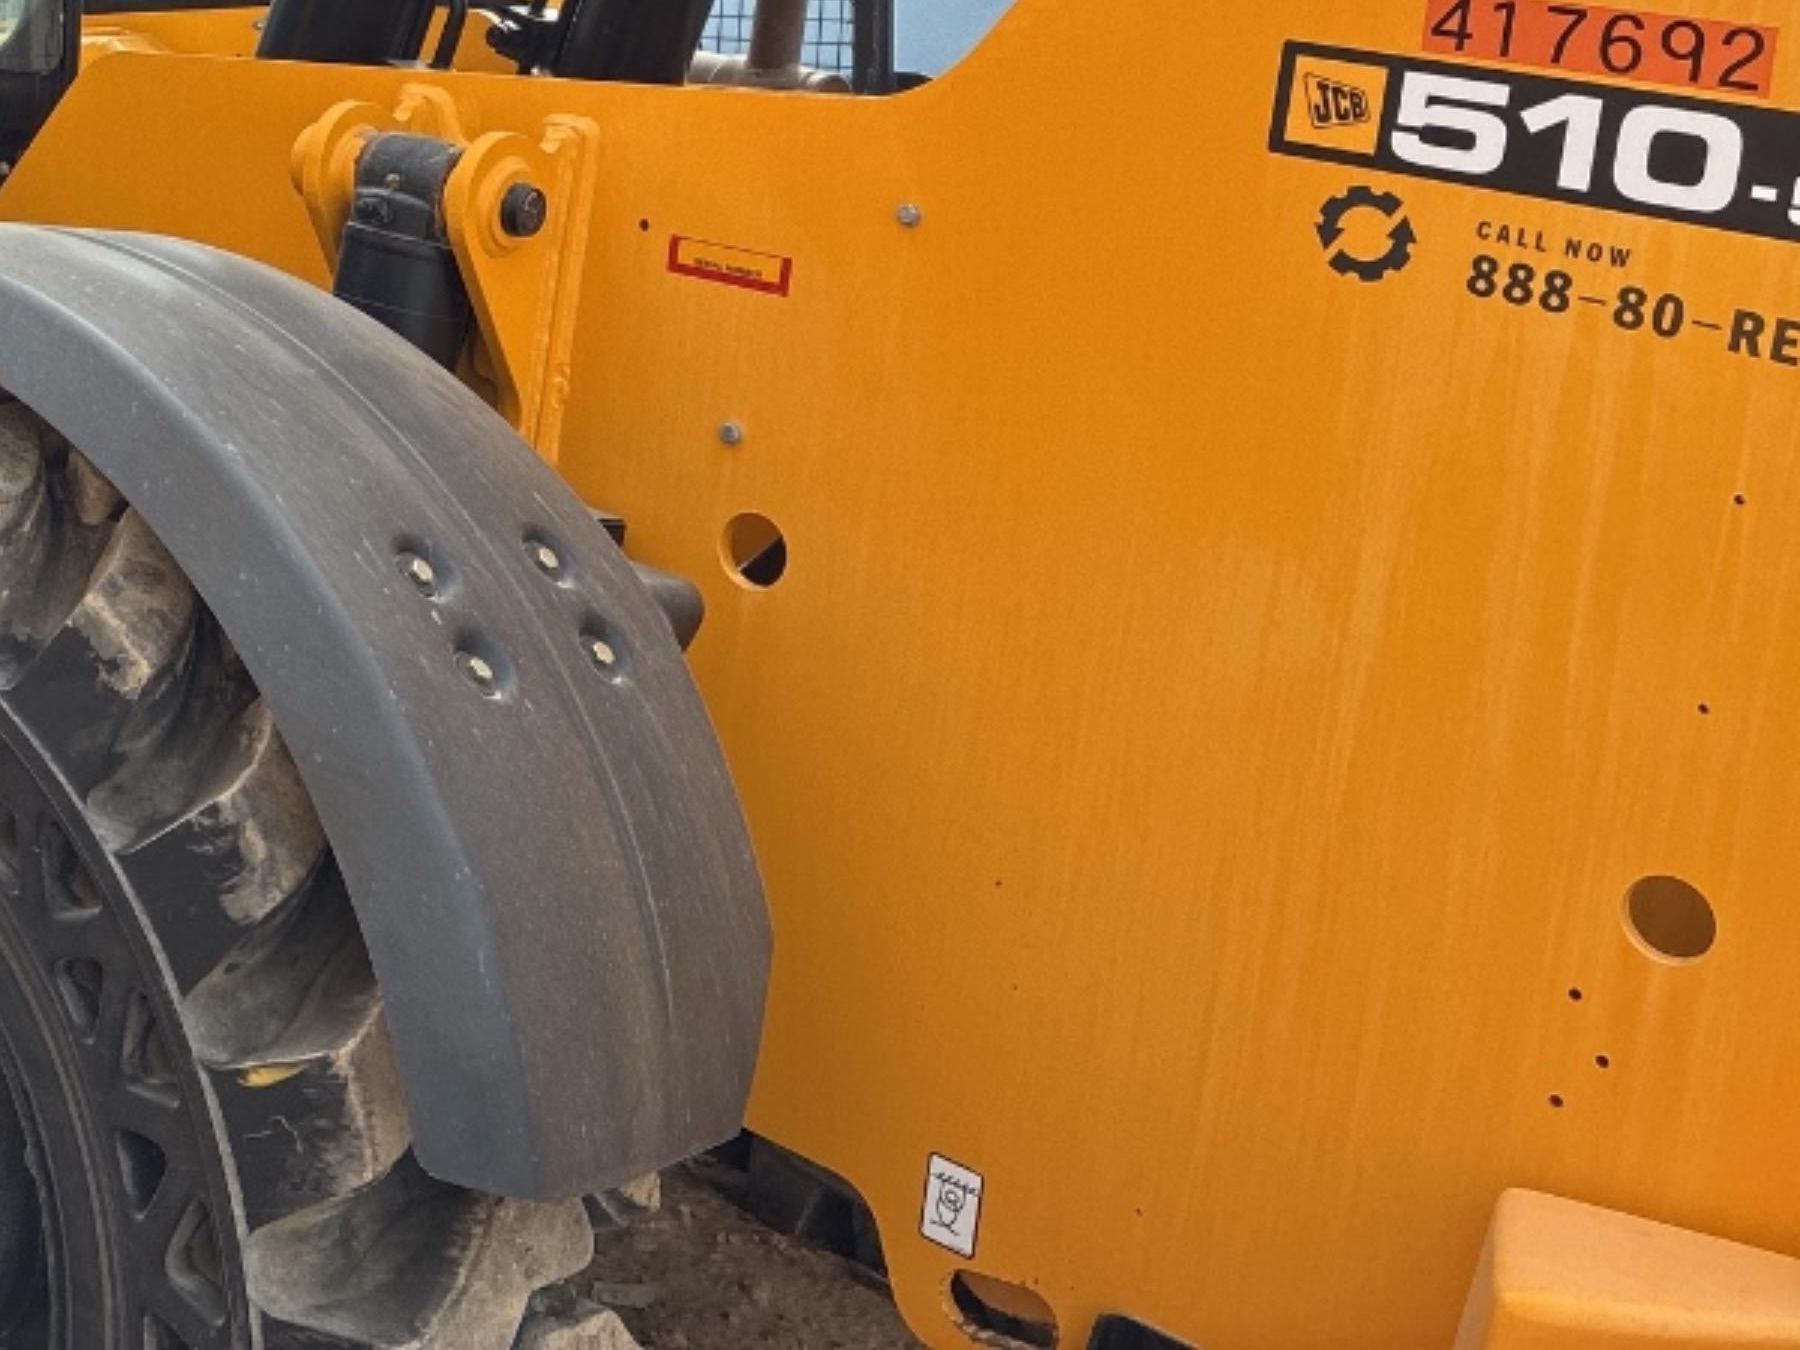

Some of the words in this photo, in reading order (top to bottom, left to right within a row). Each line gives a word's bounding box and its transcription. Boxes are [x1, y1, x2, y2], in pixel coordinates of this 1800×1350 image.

[1312, 82, 1367, 125] JCB
[1476, 220, 1547, 253] CALL
[1565, 237, 1632, 268] NOW
